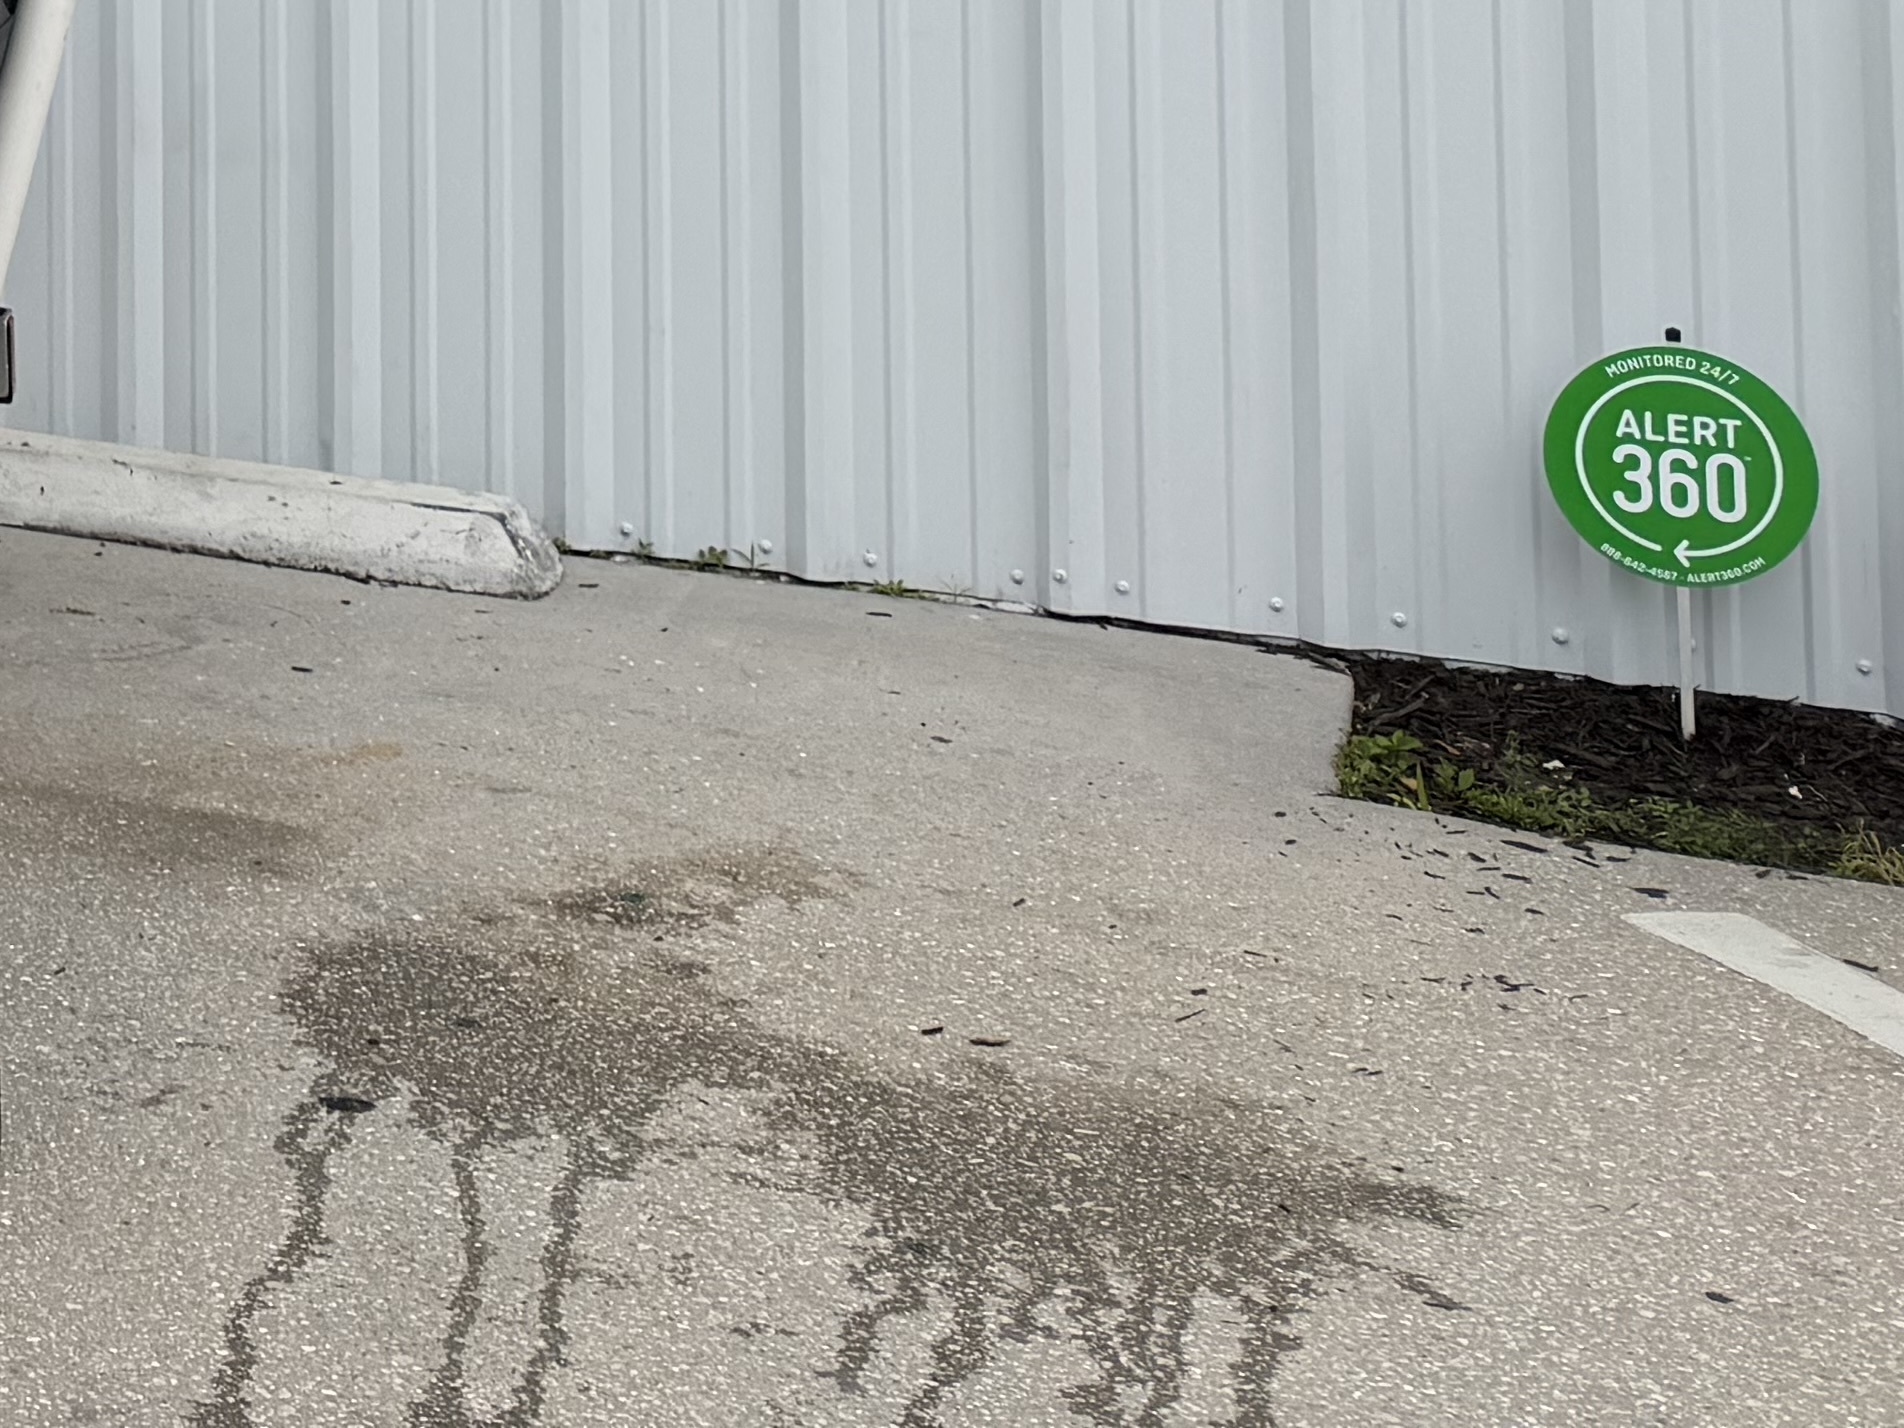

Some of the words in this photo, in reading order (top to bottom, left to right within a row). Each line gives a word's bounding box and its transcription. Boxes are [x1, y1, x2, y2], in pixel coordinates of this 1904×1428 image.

[1604, 354, 1696, 378] MONITORED
[1699, 361, 1740, 385] 24/7
[1615, 409, 1743, 449] ALERT
[1612, 444, 1747, 523] 360
